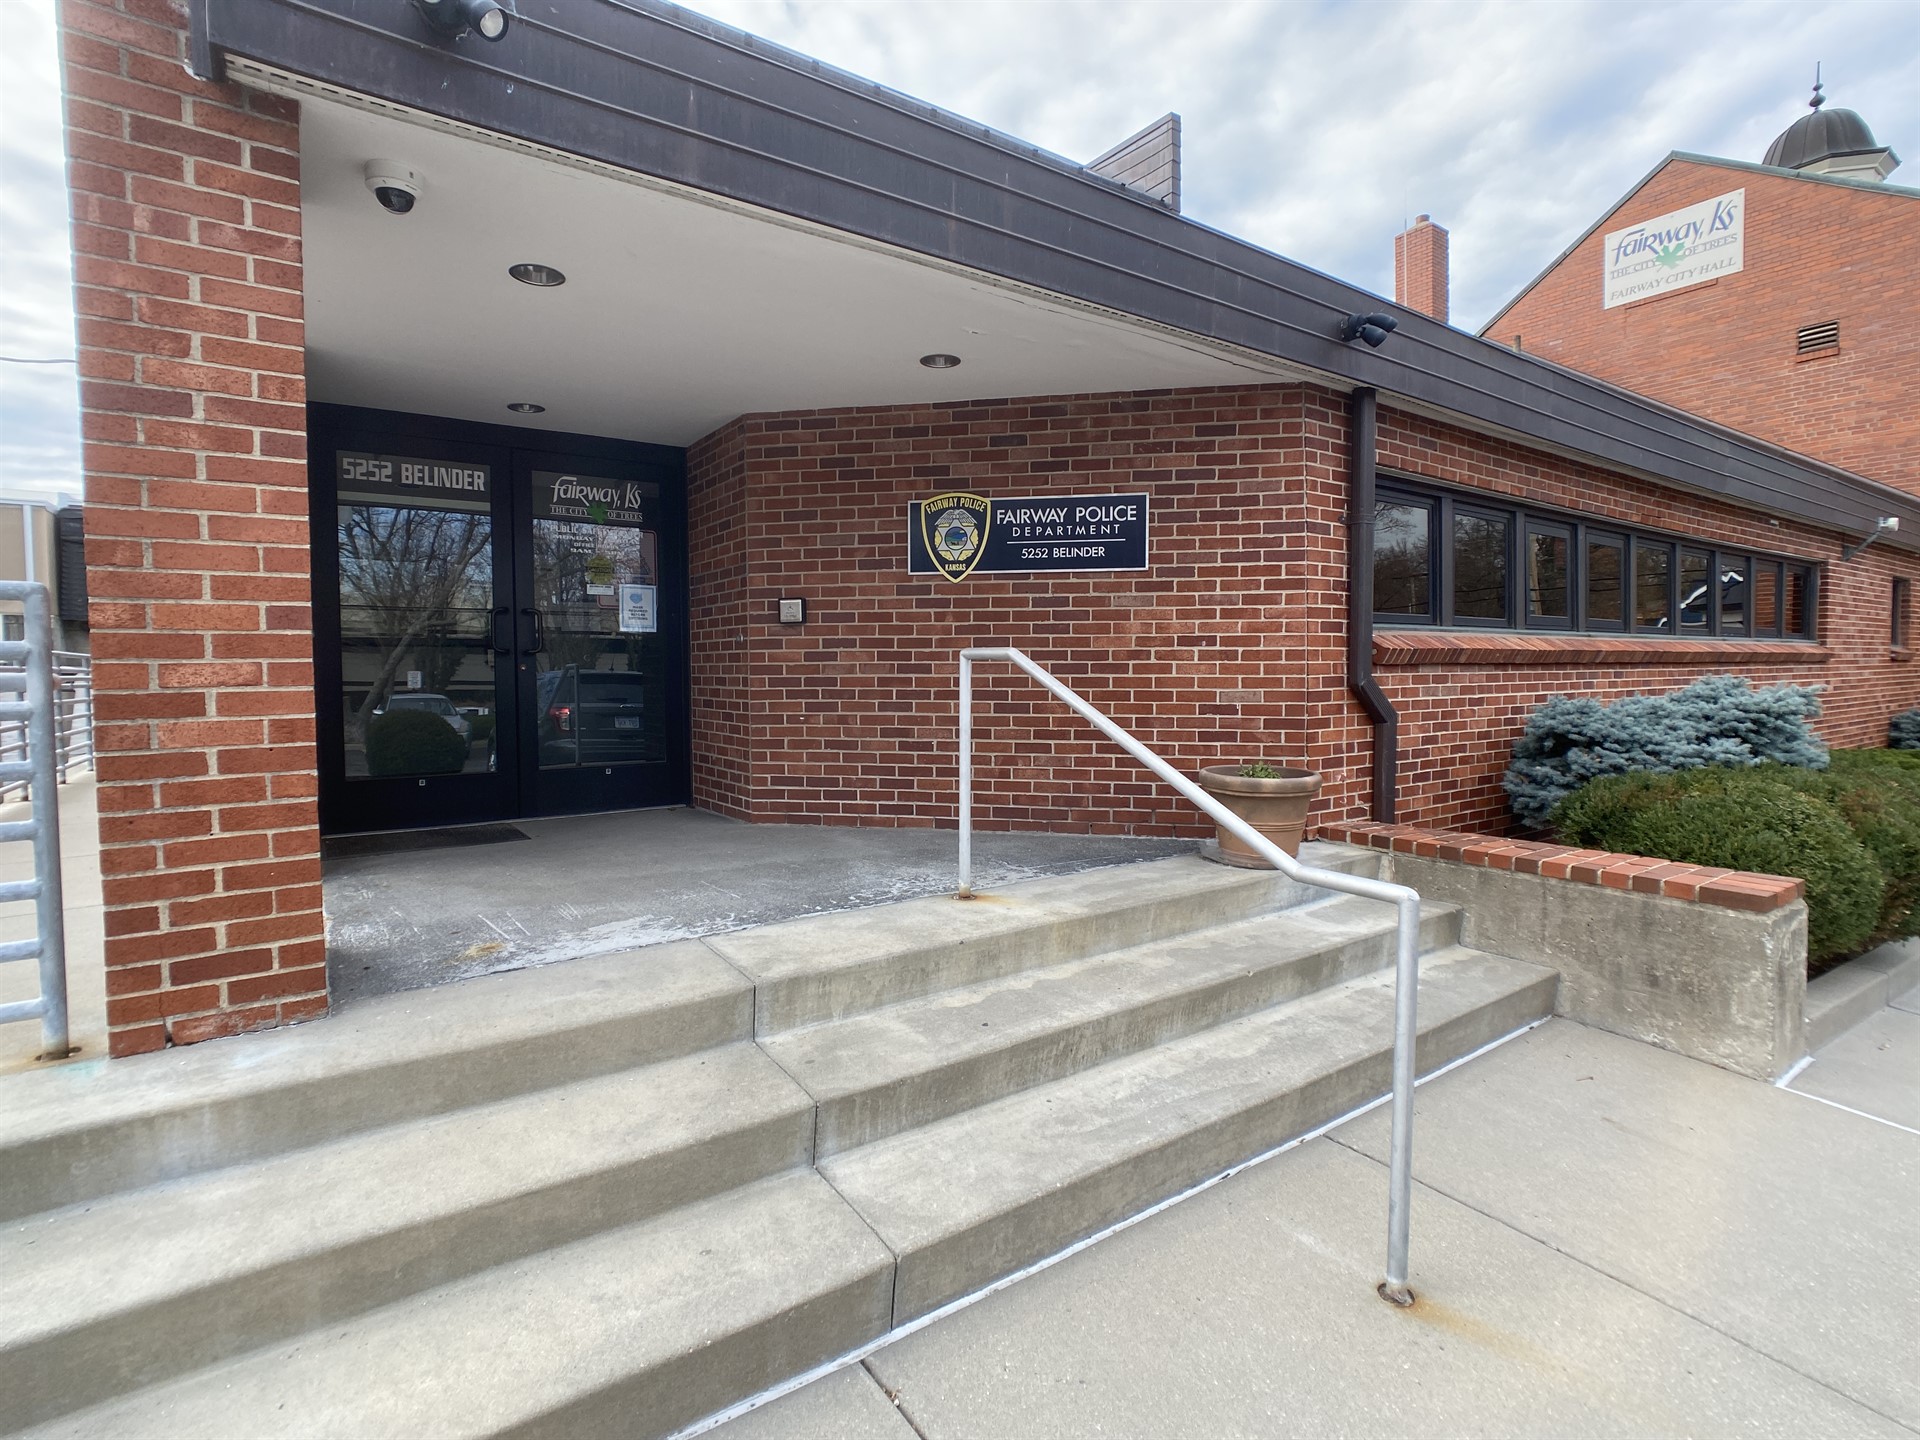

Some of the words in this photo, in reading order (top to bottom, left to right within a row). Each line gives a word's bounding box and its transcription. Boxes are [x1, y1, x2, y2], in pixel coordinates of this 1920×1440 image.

[1610, 267, 1632, 280] THE
[1633, 258, 1658, 273] CITY
[1683, 246, 1700, 258] OF
[1702, 233, 1738, 252] TREES
[1610, 277, 1664, 301] FAIRWAY
[1665, 268, 1698, 285] CITY
[1700, 257, 1737, 275] HALL
[342, 457, 393, 483] 5252
[400, 463, 486, 492] BELINDER
[551, 506, 568, 514] THE
[569, 507, 588, 516] CITY
[607, 510, 617, 518] OF
[620, 512, 643, 520] TREES
[925, 497, 958, 515] FAIRWAY
[960, 497, 987, 513] POLICE
[996, 507, 1068, 524] FAIRWAY
[1075, 505, 1137, 522] POLICE
[550, 524, 579, 534] PUBLIC
[1012, 524, 1120, 537] DEPARTMENT
[1021, 547, 1049, 559] 5252
[1052, 546, 1106, 558] BELINDER
[945, 563, 967, 572] KANSAS
